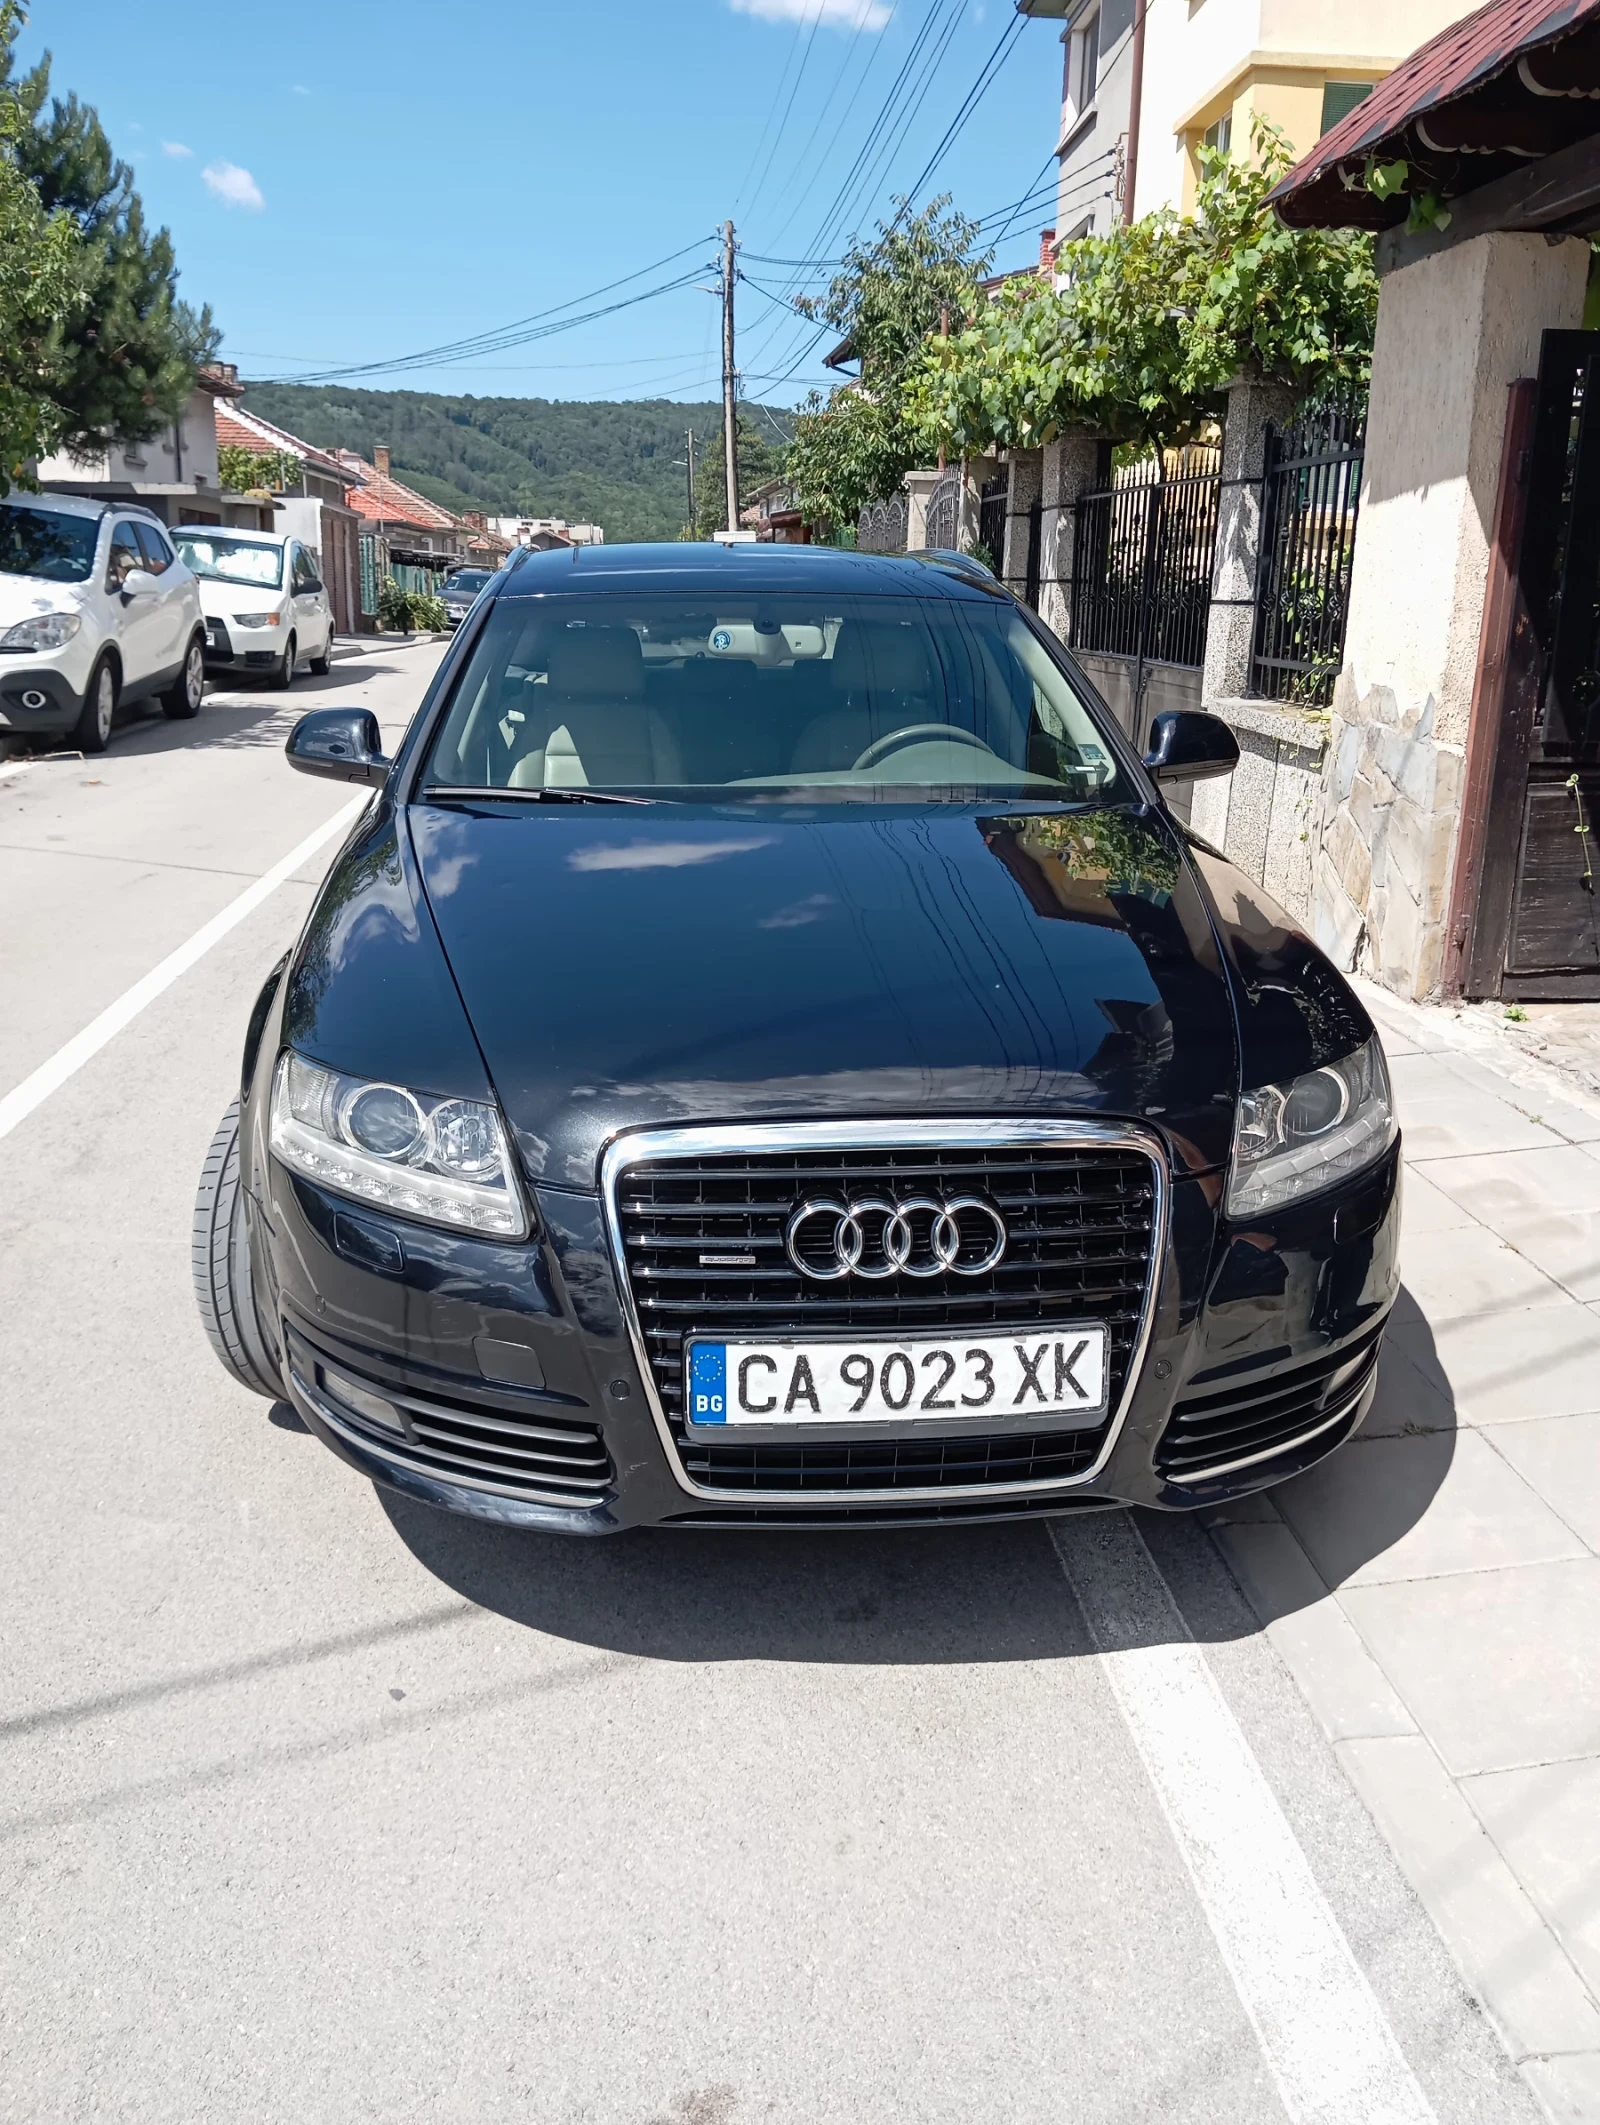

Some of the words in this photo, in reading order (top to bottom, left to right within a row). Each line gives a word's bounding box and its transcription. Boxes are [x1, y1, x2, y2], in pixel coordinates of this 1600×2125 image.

[738, 1353, 821, 1414] CA
[840, 1347, 995, 1413] 9023
[1011, 1339, 1090, 1405] XK
[696, 1394, 723, 1413] BG
